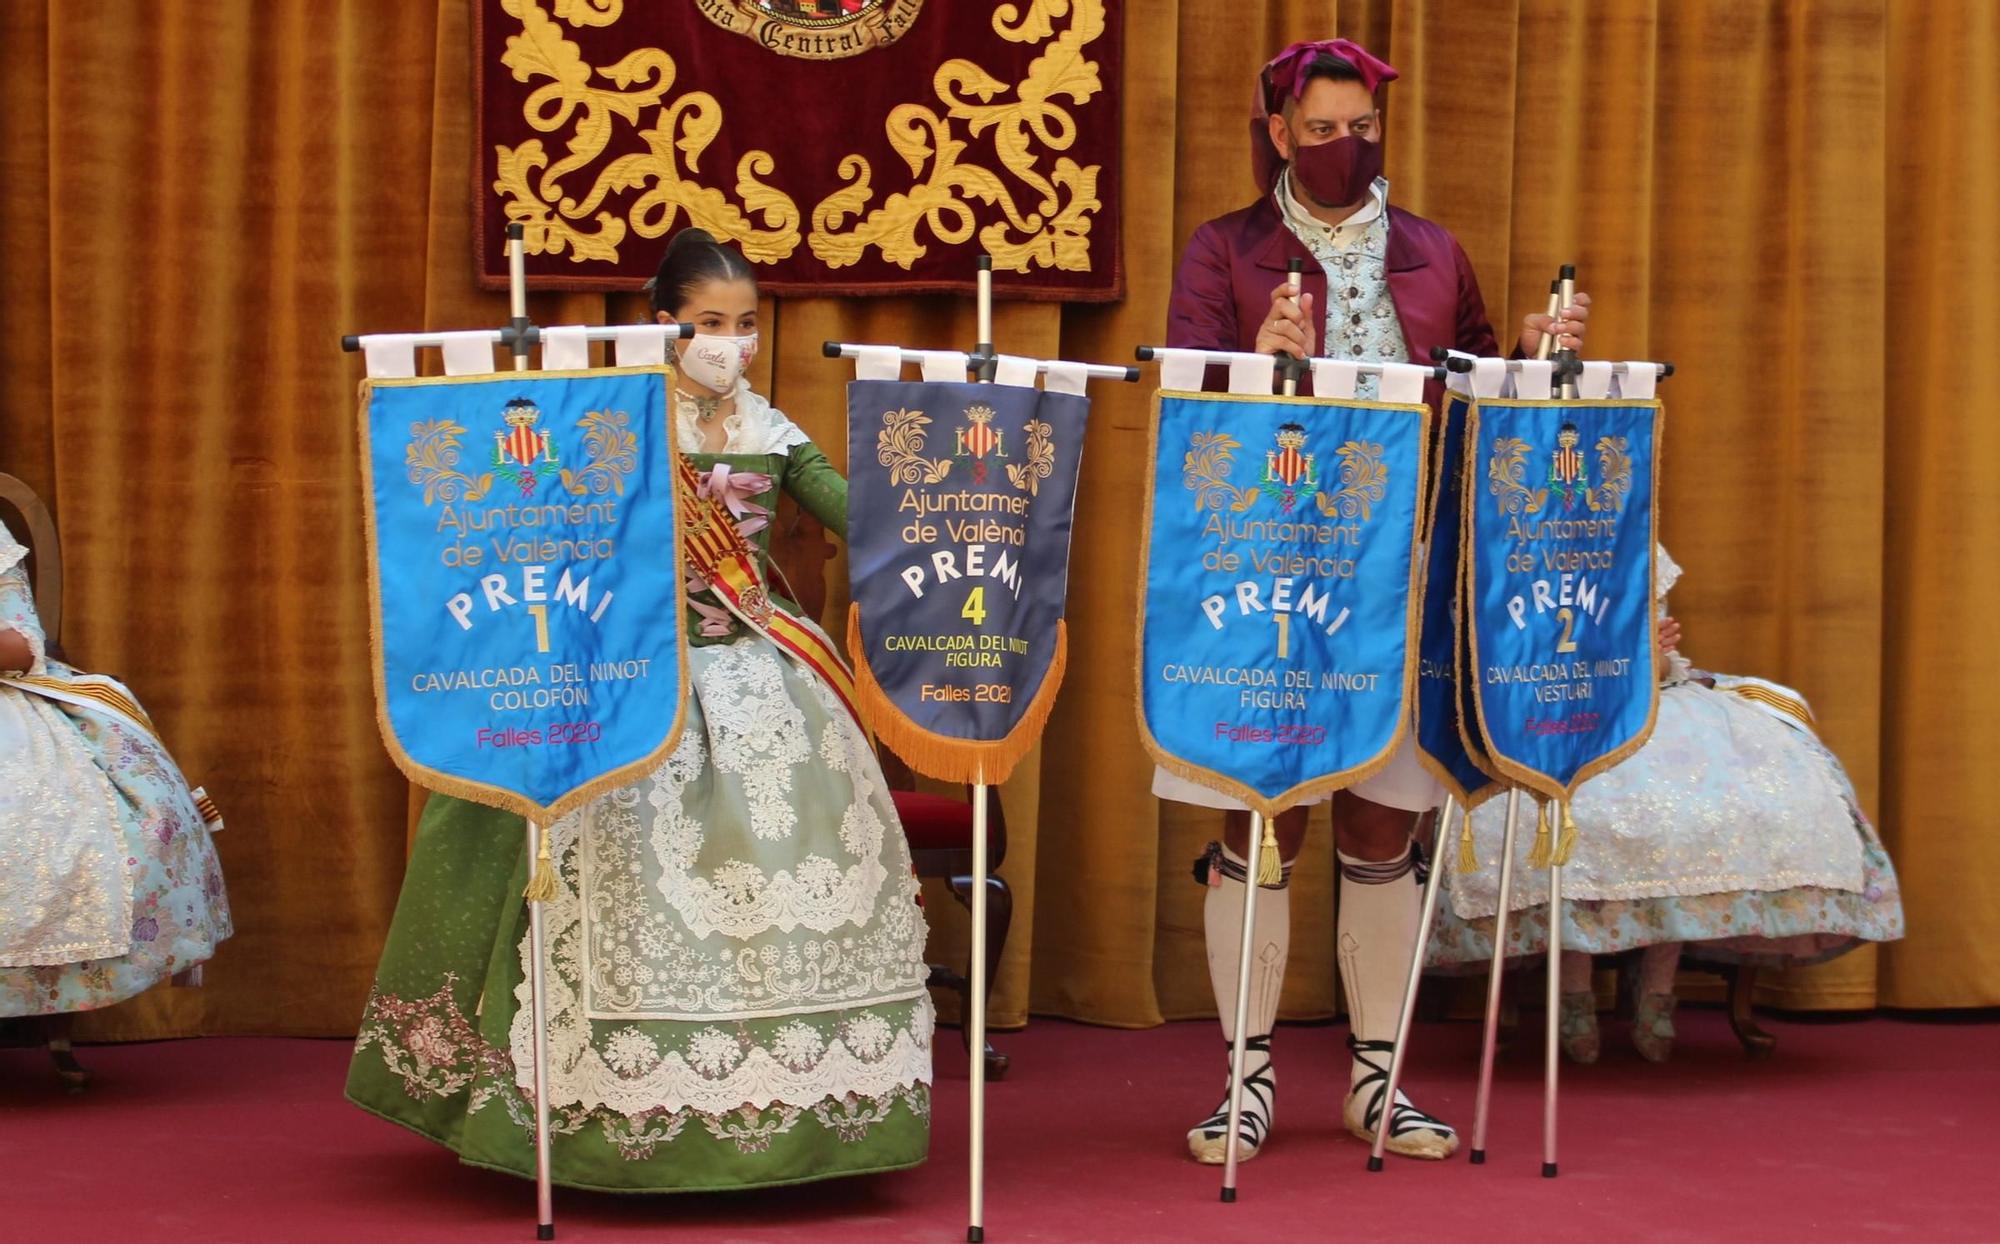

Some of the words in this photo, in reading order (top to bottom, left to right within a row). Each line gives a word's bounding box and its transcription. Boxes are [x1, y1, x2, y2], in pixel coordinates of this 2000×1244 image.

[760, 20, 863, 53] Central
[437, 500, 617, 538] Ajuntament
[902, 520, 937, 544] de
[945, 519, 1025, 547] Valènci
[1202, 513, 1360, 545] Ajuntament
[1505, 515, 1617, 546] Ajuntament
[441, 541, 483, 567] de
[492, 534, 614, 563] València
[1202, 548, 1240, 572] de
[1250, 549, 1355, 577] València
[1506, 548, 1535, 573] de
[901, 545, 1022, 600] PREMI
[446, 566, 614, 630] PREMI
[961, 586, 986, 625] 4
[1201, 578, 1350, 636] PREMI
[1507, 574, 1610, 630] PREMI
[527, 604, 549, 652] 1
[885, 635, 975, 651] CAVALCADA
[980, 635, 1006, 650] DEL
[1273, 613, 1289, 659] 1
[1556, 608, 1577, 653] 2
[945, 652, 1002, 667] FIGURA
[1487, 663, 1568, 684] CAVALCADA
[412, 666, 541, 692] CAVALCADA
[551, 664, 582, 683] DEL
[590, 660, 650, 682] NINOT
[1163, 665, 1277, 687] CAVALCADA
[1285, 671, 1313, 689] DEL
[1321, 673, 1379, 691] NINOT
[490, 686, 588, 710] COLOFÓN
[921, 685, 970, 702] Falles
[1240, 691, 1305, 710] FIGURA
[1534, 682, 1592, 703] VESTUARI
[477, 728, 542, 748] Falles
[549, 722, 600, 743] 2020
[1215, 721, 1273, 742] Falles
